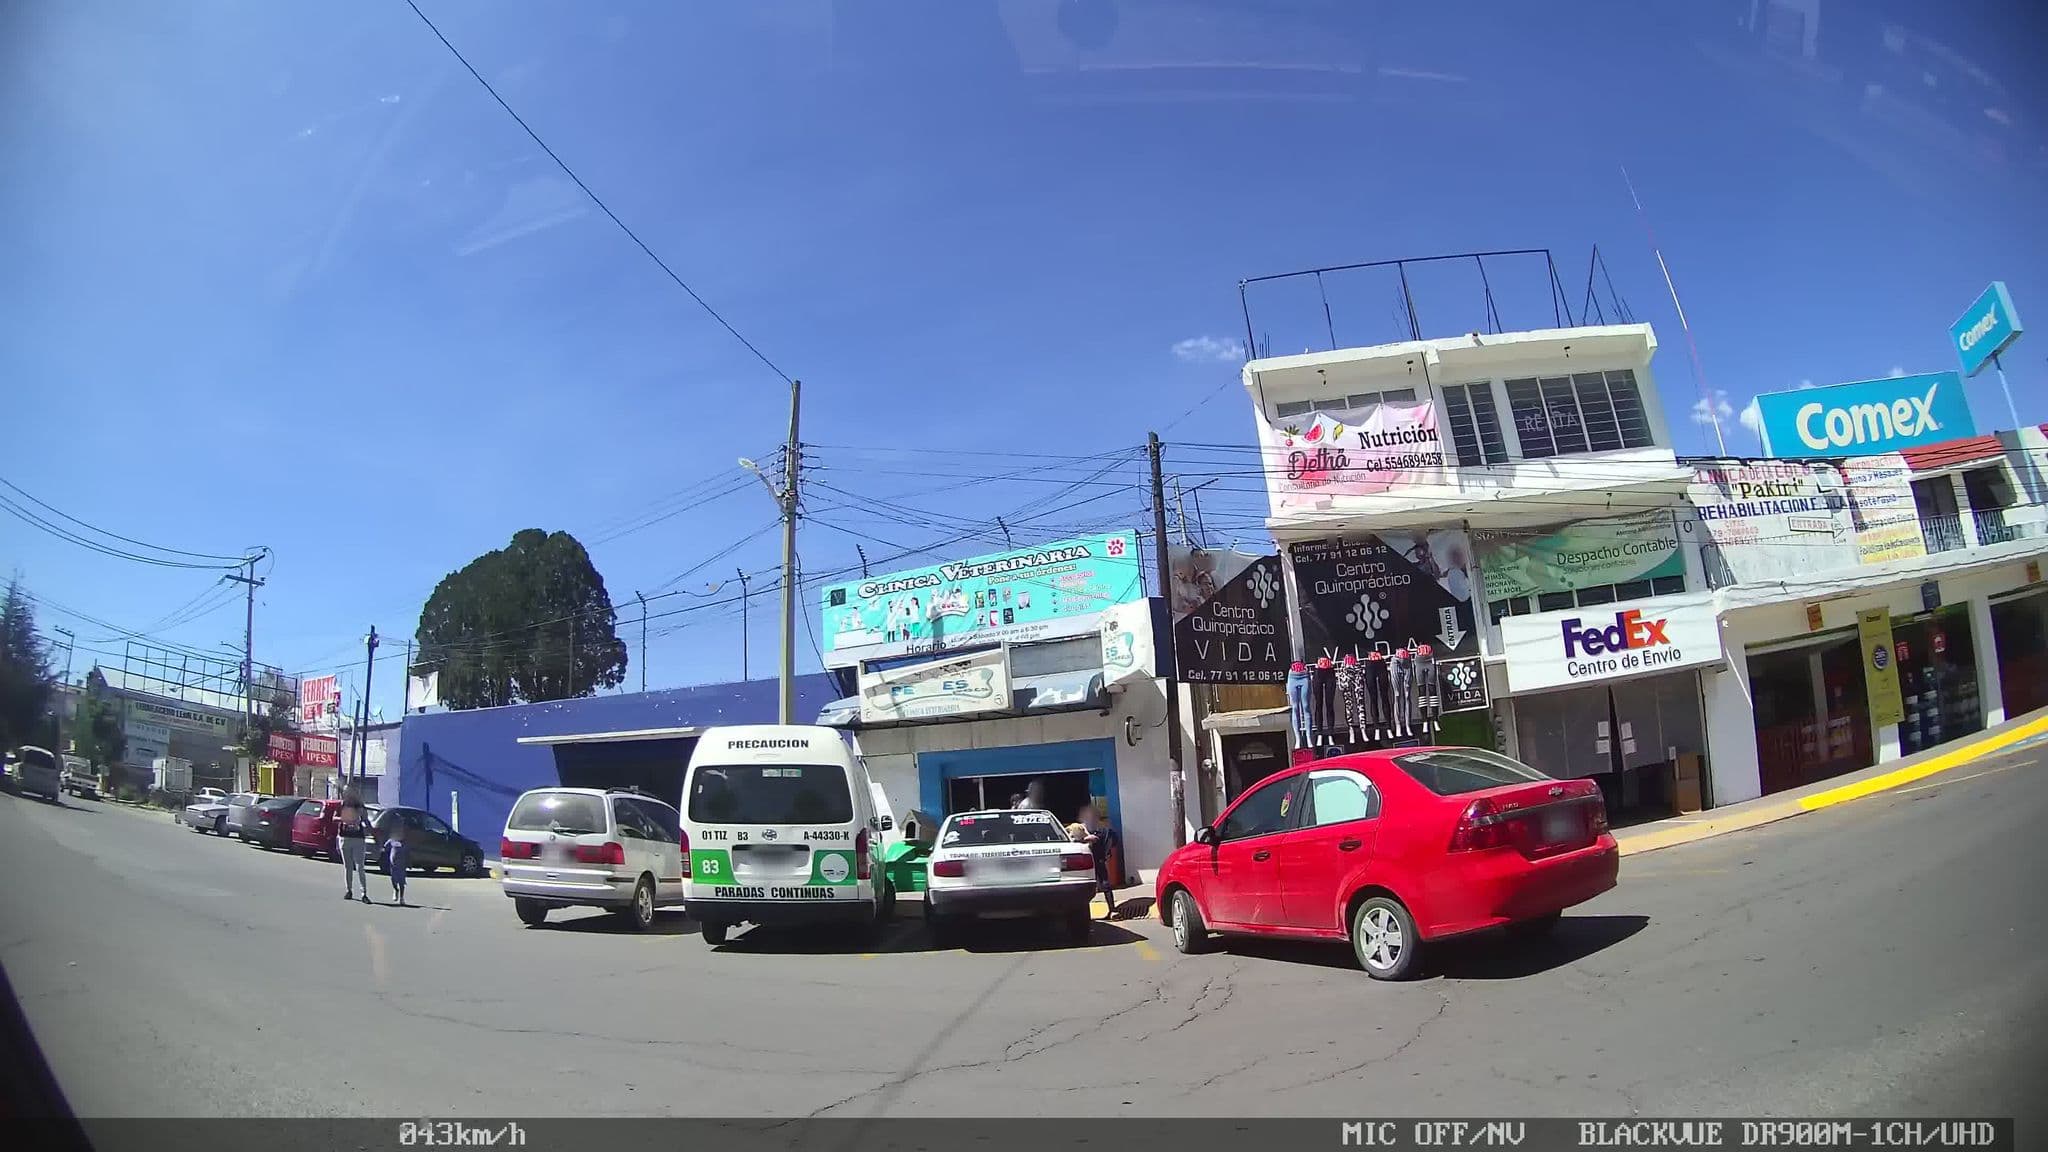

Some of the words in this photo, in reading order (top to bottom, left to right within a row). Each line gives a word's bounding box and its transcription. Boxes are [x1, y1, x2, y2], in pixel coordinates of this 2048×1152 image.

[1959, 302, 1999, 351] Comex
[1796, 382, 1940, 450] Comex
[1358, 424, 1439, 450] Nutrición
[1698, 498, 1809, 520] REHABILITACION
[1315, 552, 1326, 560] 77
[1330, 551, 1342, 559] 91
[1346, 549, 1357, 557] 12
[1376, 546, 1387, 554] 12
[1557, 545, 1620, 565] Despacho
[1623, 536, 1677, 556] Contable
[1336, 562, 1385, 577] Centro
[1315, 573, 1411, 594] Quiropráctico
[1213, 602, 1255, 619] Centro
[1192, 616, 1275, 637] Quiropráctico
[1444, 608, 1456, 647] ENTRADA
[1561, 609, 1671, 659] FedEx
[906, 641, 946, 654] Horario
[1195, 640, 1277, 662] VIDA
[1568, 659, 1617, 677] Centro
[1621, 652, 1639, 668] de
[1643, 646, 1682, 666] Envío
[1188, 669, 1206, 680] Cel.
[1210, 670, 1222, 680] 77
[1225, 671, 1238, 680] 91
[1242, 671, 1254, 680] 12
[1258, 671, 1270, 680] 06
[1273, 671, 1285, 680] 12
[728, 739, 809, 749] PRECAUCION
[307, 751, 332, 765] IPESA
[702, 831, 713, 841] 01
[713, 831, 728, 841] TIZ
[702, 859, 719, 874] 83
[715, 886, 765, 898] PARADAS
[771, 886, 835, 898] CONTINUAS
